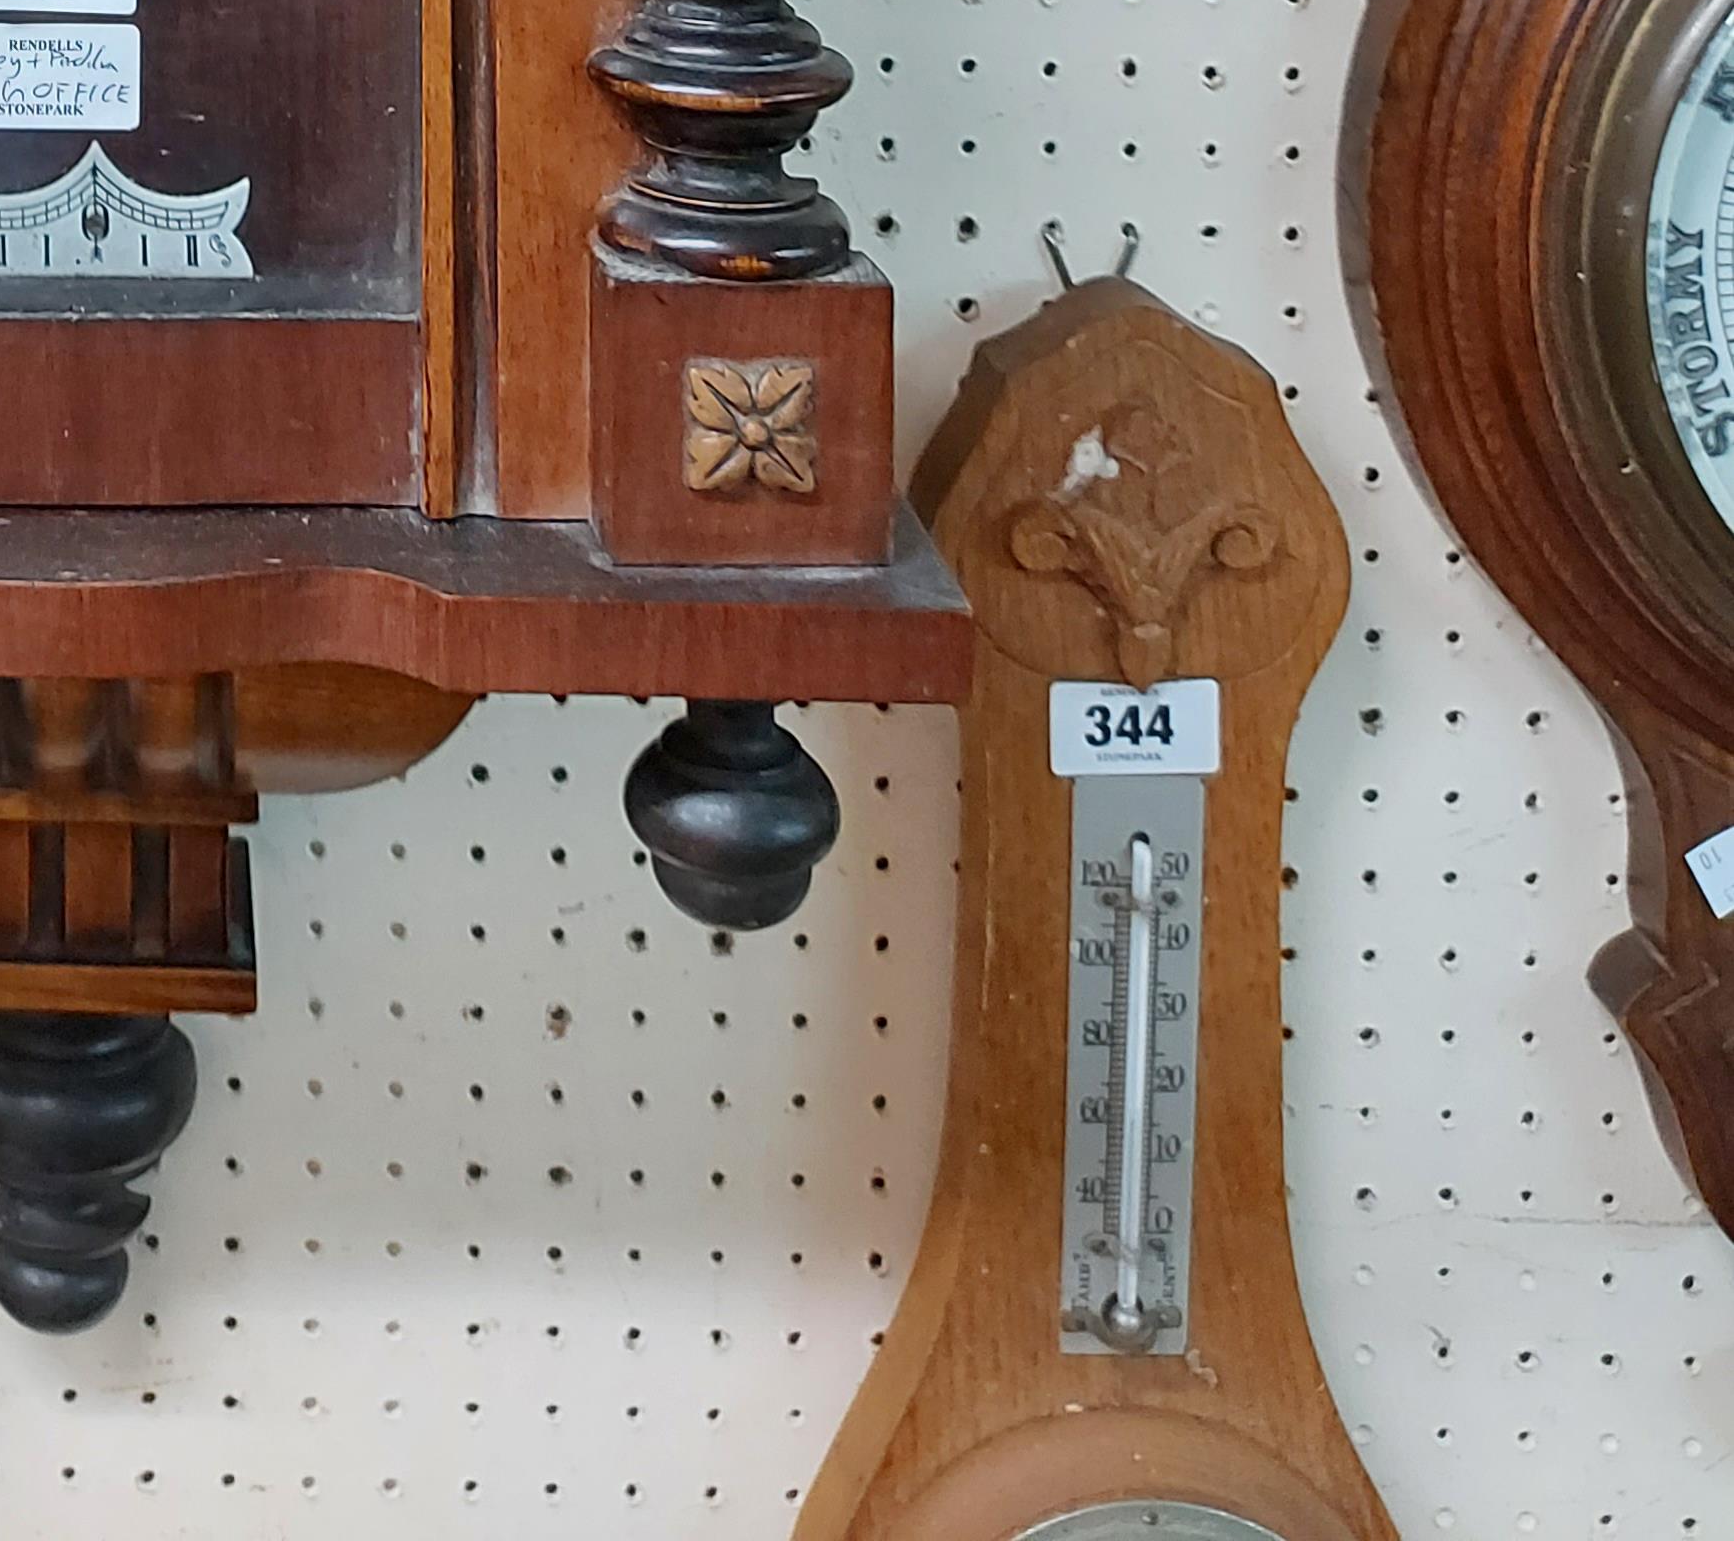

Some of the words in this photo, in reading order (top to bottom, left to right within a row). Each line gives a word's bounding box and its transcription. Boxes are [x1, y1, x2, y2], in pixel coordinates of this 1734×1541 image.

[9, 39, 83, 51] RENDELLS
[33, 82, 130, 103] OFFICE
[1667, 220, 1734, 457] STORMY
[1085, 704, 1174, 747] 344
[1160, 852, 1190, 876] 50
[1078, 938, 1115, 965] 100
[1082, 1019, 1114, 1043] 80
[1156, 992, 1187, 1018] 30
[1080, 1096, 1108, 1121] 60
[1155, 1064, 1185, 1089] 20
[1075, 1176, 1106, 1200] 40
[1154, 1134, 1181, 1158] 10
